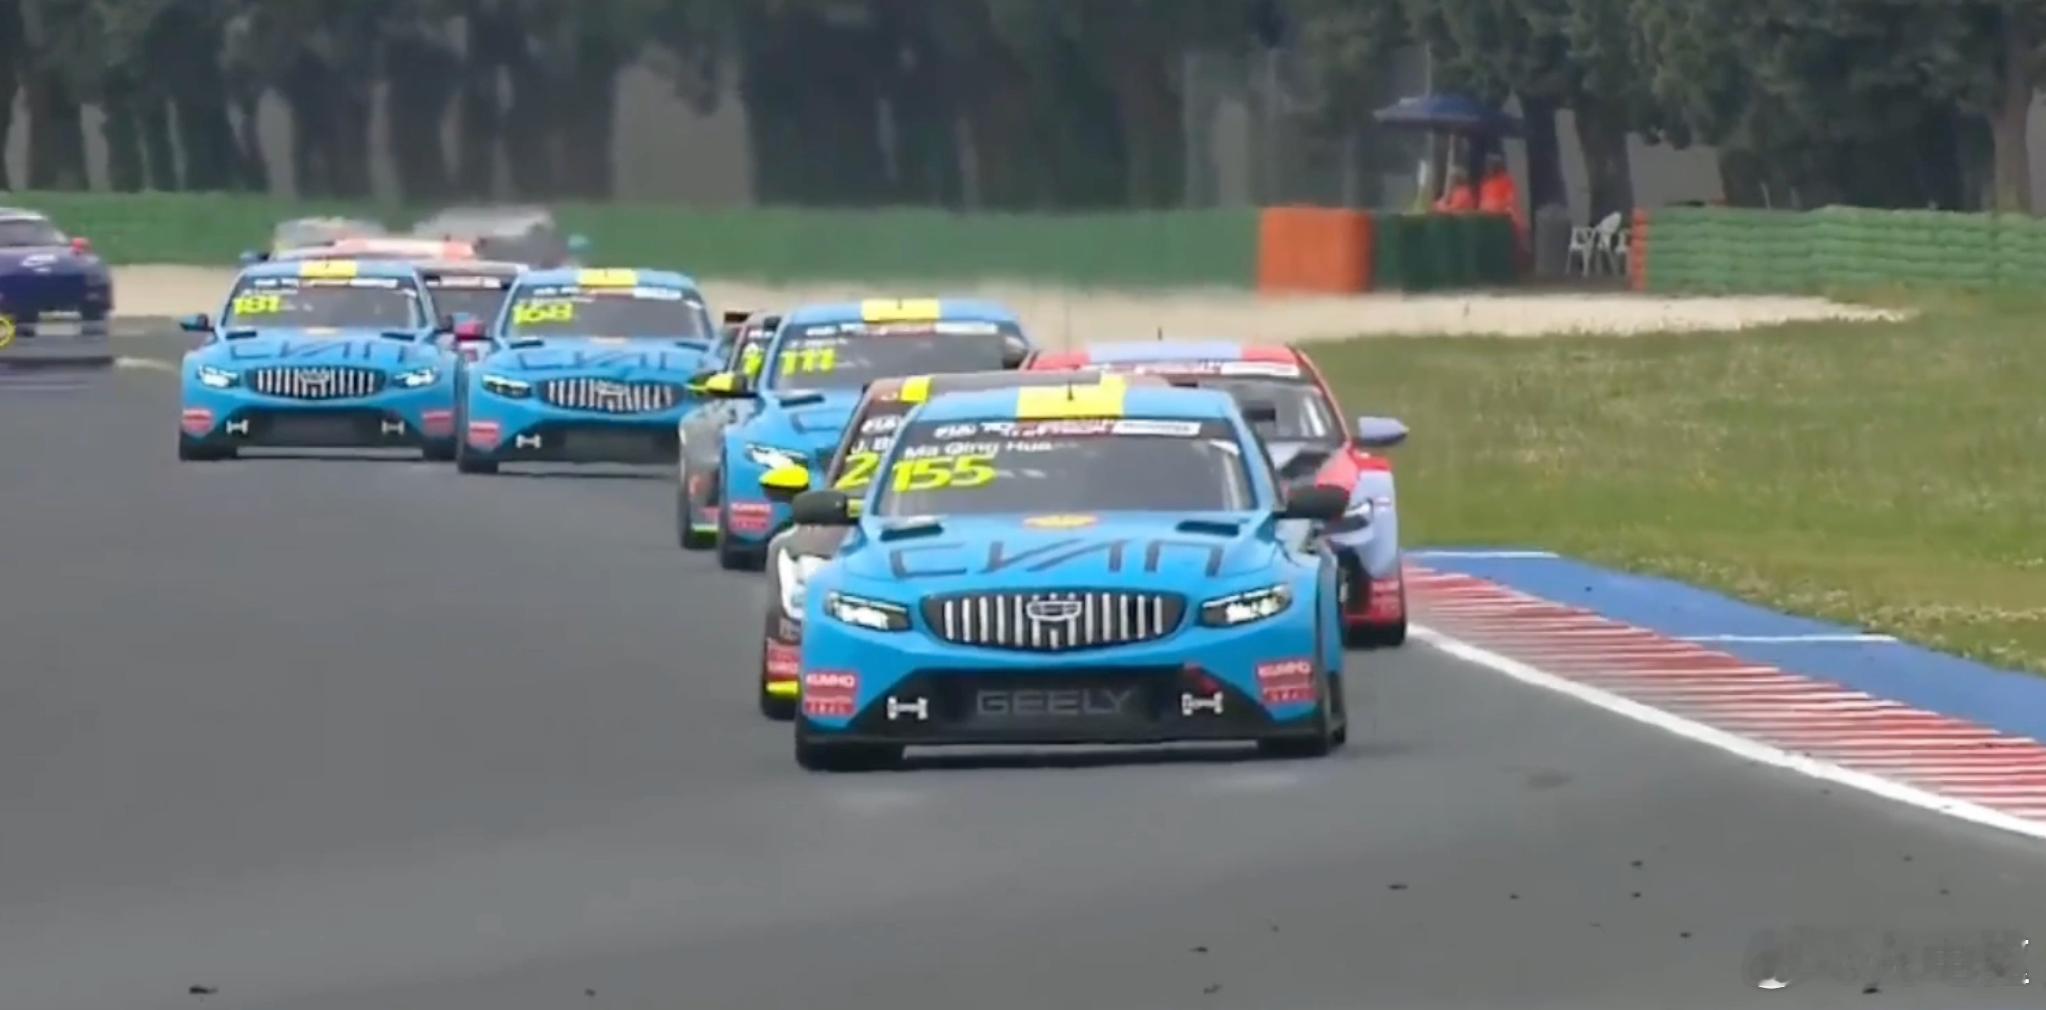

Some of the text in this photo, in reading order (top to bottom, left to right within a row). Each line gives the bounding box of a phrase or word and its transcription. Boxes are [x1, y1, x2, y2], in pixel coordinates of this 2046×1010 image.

[234, 296, 281, 317] 181
[904, 440, 1053, 459] Ma Qing Hua
[892, 454, 996, 492] 155
[976, 689, 1134, 716] GEELY
